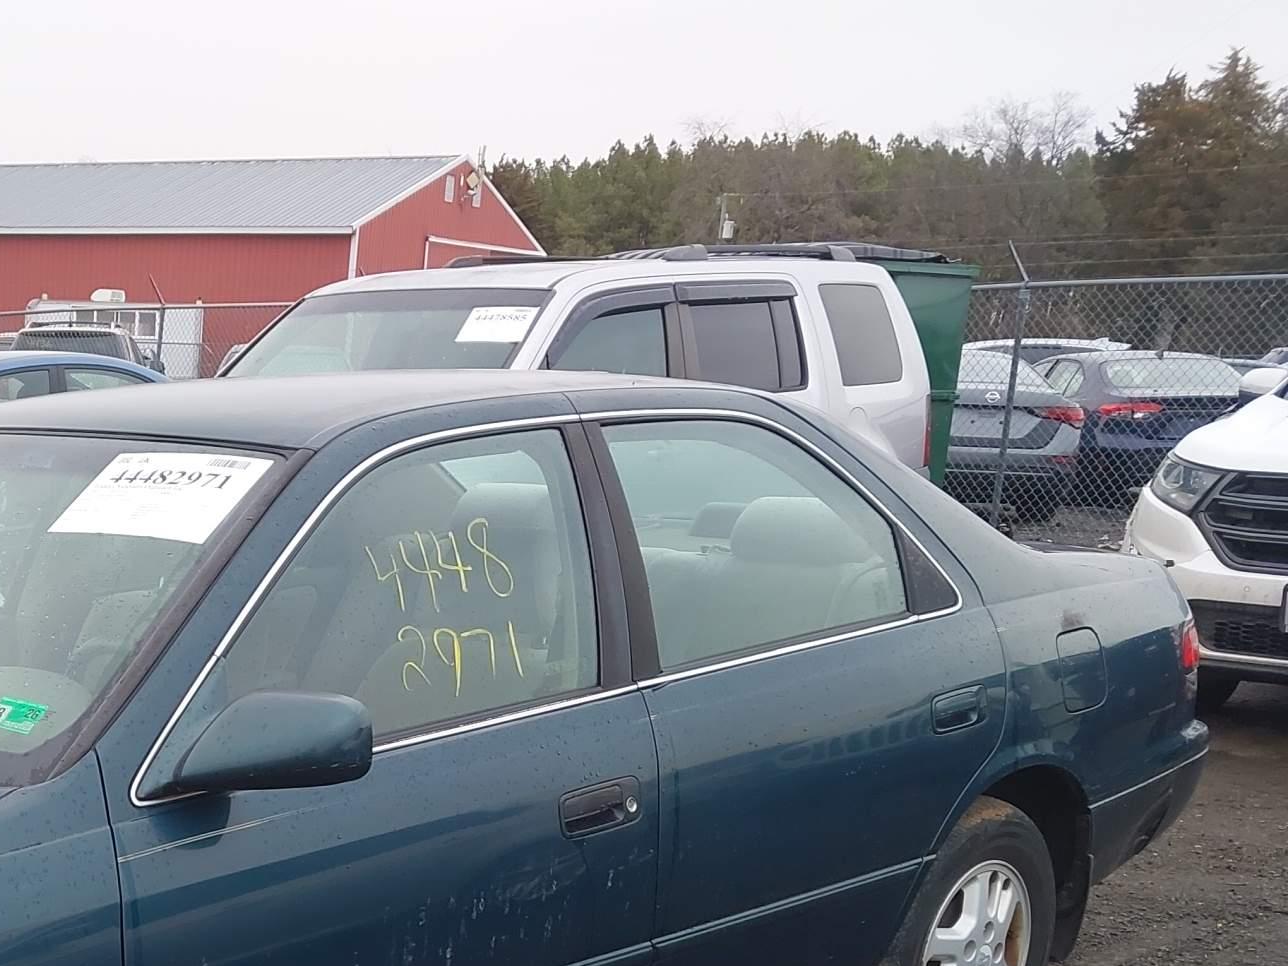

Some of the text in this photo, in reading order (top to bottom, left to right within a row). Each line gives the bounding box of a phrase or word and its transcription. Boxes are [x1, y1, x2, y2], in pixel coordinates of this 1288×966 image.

[110, 469, 232, 489] 44482971
[365, 518, 513, 613] 4448
[398, 620, 524, 697] 2971
[24, 708, 41, 719] 26
